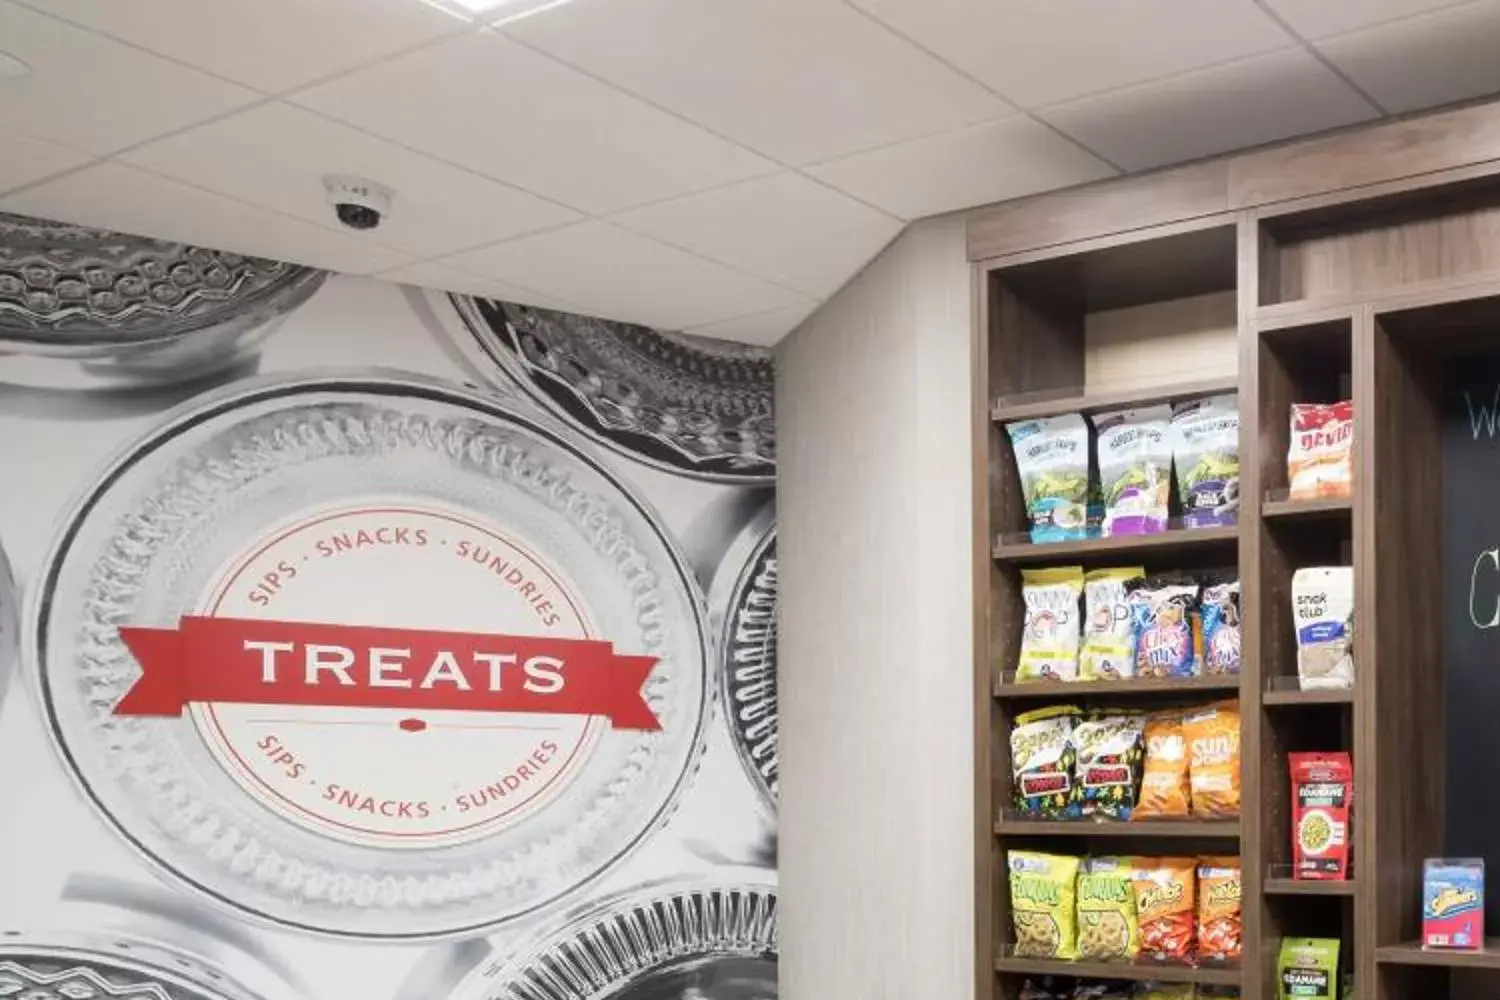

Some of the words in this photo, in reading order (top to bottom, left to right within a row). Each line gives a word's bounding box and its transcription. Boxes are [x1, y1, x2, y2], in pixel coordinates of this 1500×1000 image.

[248, 560, 298, 607] SIPS
[315, 526, 429, 558] SNACKS
[455, 539, 561, 628] SUNDRIES
[243, 638, 567, 694] TREATS
[256, 733, 306, 780] SIPS
[321, 782, 431, 819] SNACKS
[455, 737, 558, 813] SUNDRIES
